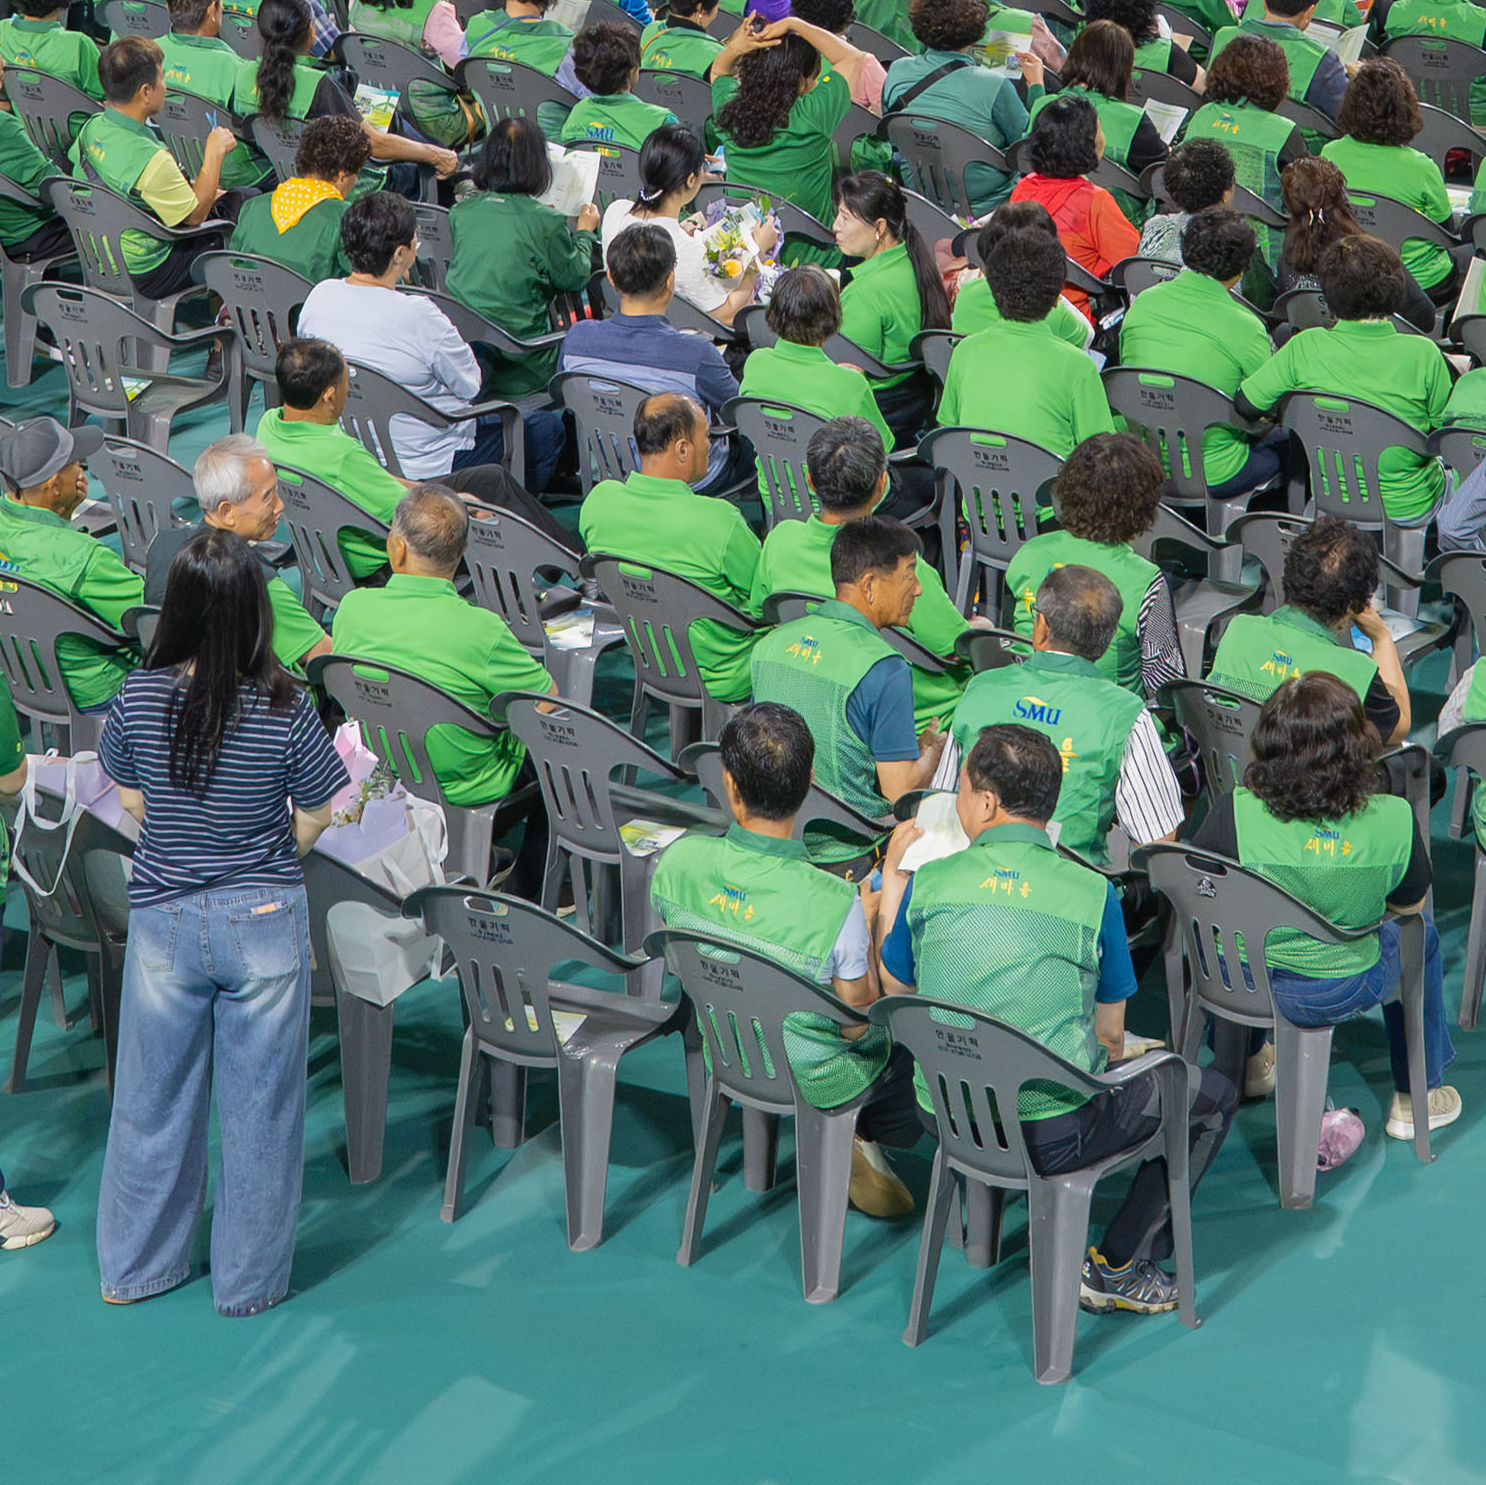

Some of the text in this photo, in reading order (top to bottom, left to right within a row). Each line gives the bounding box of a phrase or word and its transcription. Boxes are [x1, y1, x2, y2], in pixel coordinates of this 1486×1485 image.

[1012, 699, 1063, 726] SMU
[1304, 837, 1353, 857] 새마을
[978, 875, 1032, 897] 새마을
[709, 893, 755, 921] 새마을
